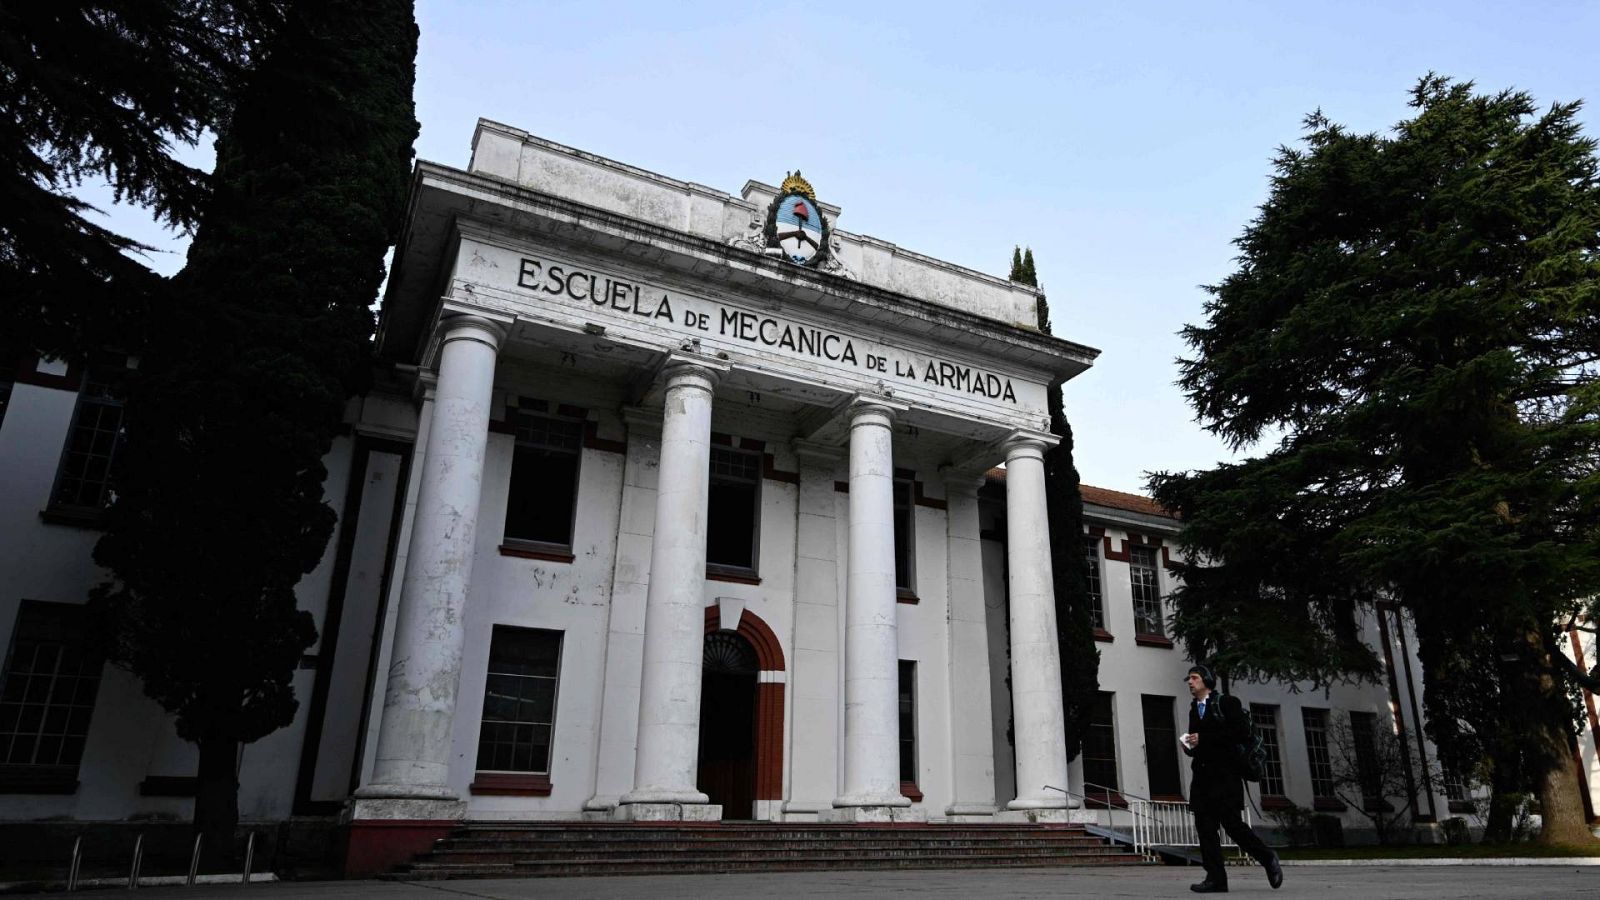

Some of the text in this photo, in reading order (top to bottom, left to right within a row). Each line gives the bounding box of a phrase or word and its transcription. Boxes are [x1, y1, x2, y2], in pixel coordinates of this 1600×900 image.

[517, 258, 1017, 404] ESCUELA DE MECANICA DE LA ARMADA
